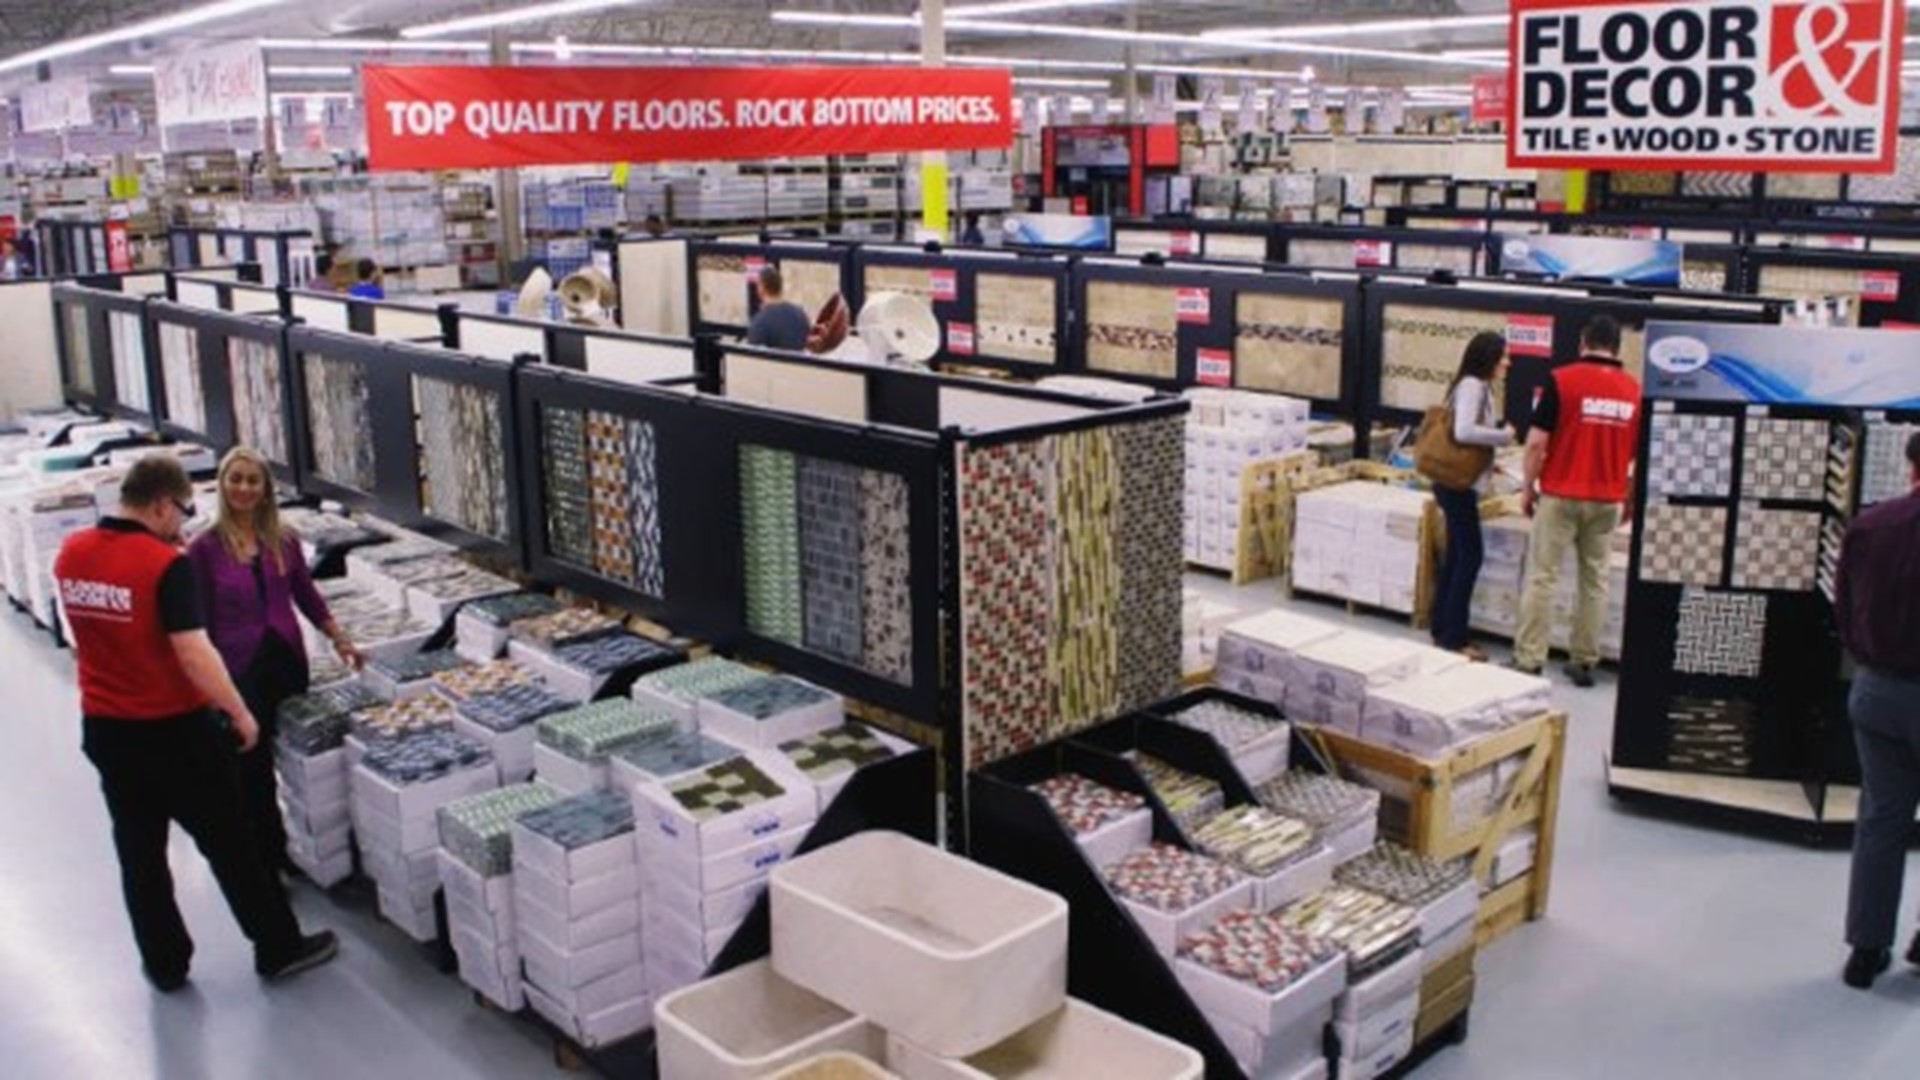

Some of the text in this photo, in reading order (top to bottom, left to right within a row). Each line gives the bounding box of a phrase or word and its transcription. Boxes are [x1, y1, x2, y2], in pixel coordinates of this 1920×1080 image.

[1524, 6, 1758, 66] FLOOR
[385, 95, 1001, 138] TOP QUALITY FLOORS. ROCK BOTTOM PRICES.
[1523, 66, 1757, 119] DECOR
[1523, 127, 1875, 153] TILE WOOD STONE
